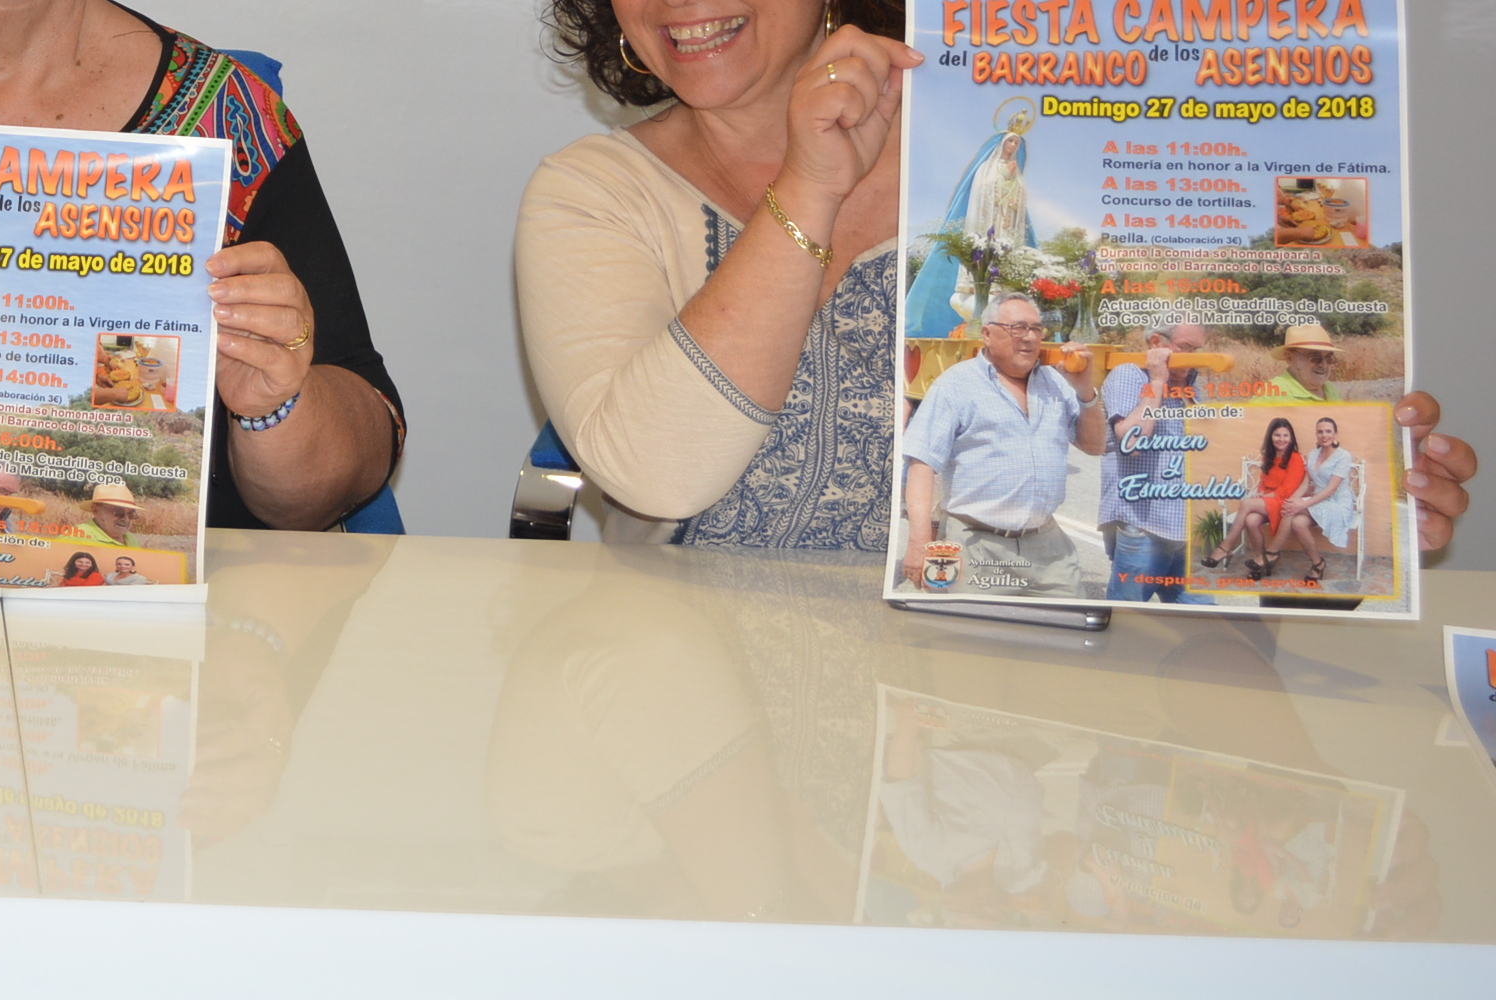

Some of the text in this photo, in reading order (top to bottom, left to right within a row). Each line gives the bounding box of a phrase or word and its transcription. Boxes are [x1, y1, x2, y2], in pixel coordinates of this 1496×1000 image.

[939, 44, 1373, 86] del BARRANCO de los ASENSIOS
[1043, 97, 1374, 121] Domingo 27 de mayo de 2018
[1103, 141, 1247, 156] A las 11:00h.
[1103, 158, 1390, 174] Romería en honor a la Virgen de Fátima.
[1102, 176, 1247, 192] A las 13:00h.
[1102, 194, 1256, 208] Concurso de tortillas.
[18, 196, 41, 214] los
[34, 201, 196, 244] ASENSIOS
[1101, 214, 1247, 229] A las 14:00h.
[1100, 233, 1242, 246] Paella. (Colaboración 3€)
[18, 248, 43, 270] de
[49, 254, 105, 276] mayo
[109, 253, 135, 274] de
[141, 255, 193, 275] 2018
[1100, 248, 1147, 258] Durante
[1151, 248, 1160, 258] la
[1166, 249, 1209, 258] comida
[1230, 249, 1310, 262] homenajeará
[1100, 261, 1344, 274] un vecino del Barranco de los Asensios.
[1100, 279, 1248, 294] A las 16:00h.
[1, 293, 75, 311] 11:00h.
[1099, 299, 1388, 312] Actuación de las Cuadrillas de la Cuesta
[1100, 312, 1320, 327] de Gos y de la Marina de Cope.
[1140, 381, 1287, 398] A las 18:00h.
[1143, 405, 1244, 419] Actuación de:
[1120, 426, 1207, 454] Carmen
[1162, 454, 1181, 478] y
[1119, 474, 1246, 501] Esmeralda
[16, 520, 91, 539] 18:00h.
[969, 559, 1031, 567] Ayuntamiento
[967, 572, 1028, 589] Águilas
[1118, 572, 1129, 582] Y
[1216, 577, 1255, 588] gran
[1261, 578, 1322, 589] sorteo.
